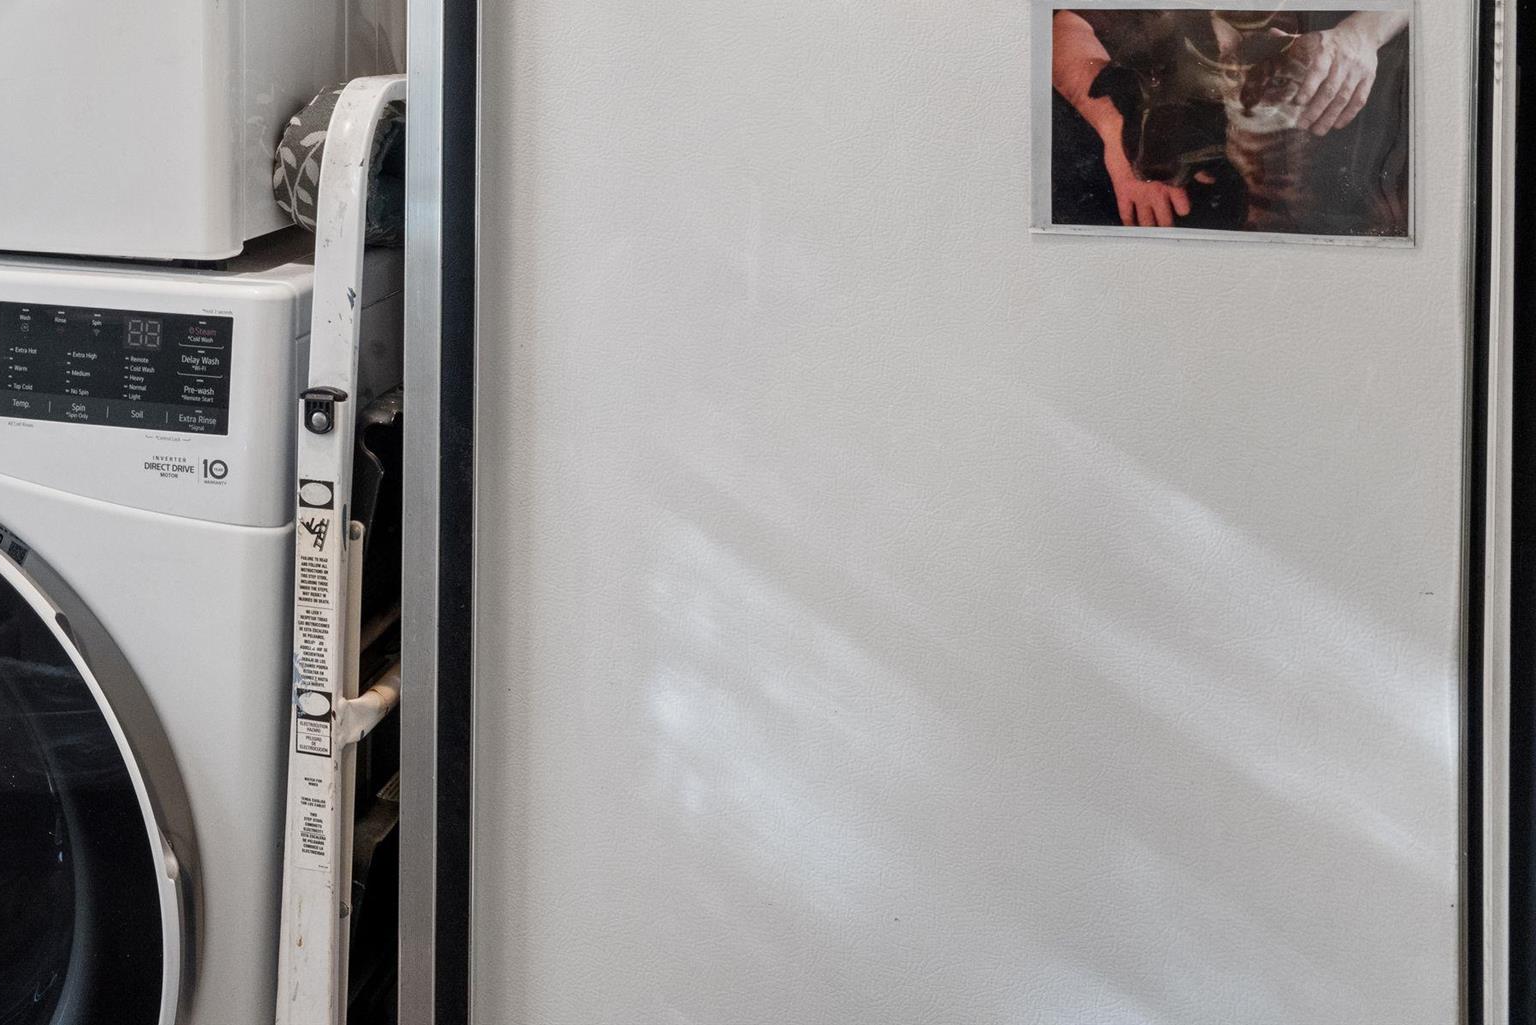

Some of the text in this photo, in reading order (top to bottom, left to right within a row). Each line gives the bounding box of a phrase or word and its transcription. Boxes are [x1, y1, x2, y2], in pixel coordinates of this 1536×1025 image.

[86, 353, 98, 361] High
[130, 356, 149, 364] Remote
[181, 355, 220, 366] Delay Wash
[142, 366, 155, 374] Wash
[79, 389, 89, 397] Spin
[129, 384, 147, 392] Normal
[184, 386, 215, 396] Pre-wash
[129, 393, 141, 401] Light
[12, 399, 30, 409] Temp.
[72, 403, 86, 413] Spin
[130, 409, 144, 419] Soil
[178, 413, 217, 425] Extra Rinse
[152, 455, 186, 463] INVERTER
[144, 462, 195, 474] DIRECT DRIVE
[202, 458, 229, 480] 10
